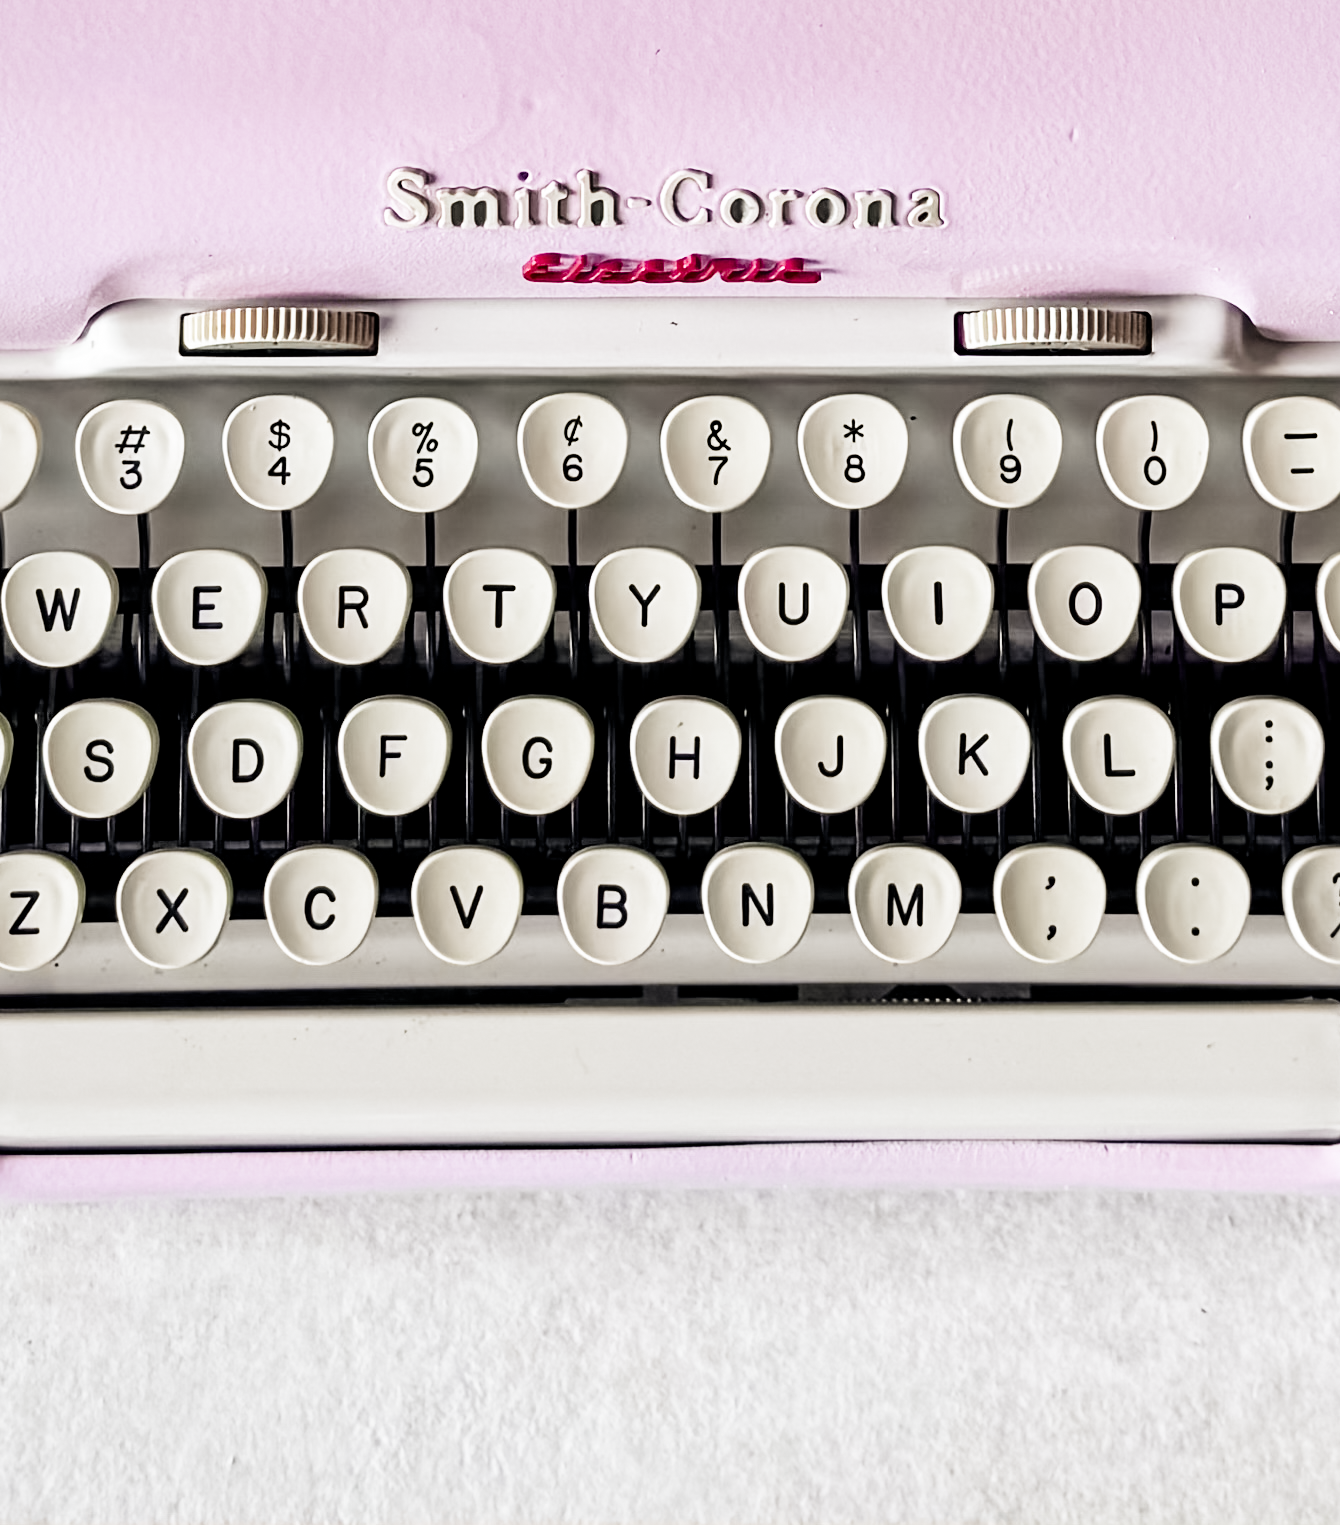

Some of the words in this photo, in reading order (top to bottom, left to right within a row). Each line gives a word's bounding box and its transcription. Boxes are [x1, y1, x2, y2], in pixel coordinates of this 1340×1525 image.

[383, 166, 947, 229] Smith-Corona
[114, 424, 151, 454] #
[268, 418, 291, 452] $
[411, 421, 439, 455] %
[706, 419, 732, 452] &
[1006, 418, 1014, 452] (
[1150, 420, 1159, 453] )
[119, 459, 143, 490] 3
[267, 456, 291, 486] 4
[412, 458, 434, 488] 5
[562, 453, 583, 482] 6
[708, 455, 729, 486] 7
[843, 454, 866, 484] 8
[999, 454, 1022, 484] 9
[1143, 455, 1167, 486] 0
[35, 587, 81, 633] W
[192, 585, 224, 630] E
[337, 585, 369, 629] R
[482, 584, 516, 629] T
[628, 583, 661, 628] Y
[778, 582, 810, 626] U
[1068, 581, 1103, 626] O
[1214, 583, 1245, 626] P
[83, 739, 115, 783] S
[231, 738, 264, 784] D
[379, 734, 408, 778] F
[521, 736, 553, 780] G
[668, 735, 701, 780] H
[817, 734, 844, 778] J
[958, 732, 989, 777] K
[1103, 733, 1136, 778] L
[1265, 760, 1274, 791] ;
[8, 890, 40, 936] Z
[155, 887, 189, 934] X
[304, 885, 336, 931] C
[449, 885, 484, 930] V
[596, 884, 628, 930] B
[741, 882, 774, 927] N
[886, 882, 924, 927] M
